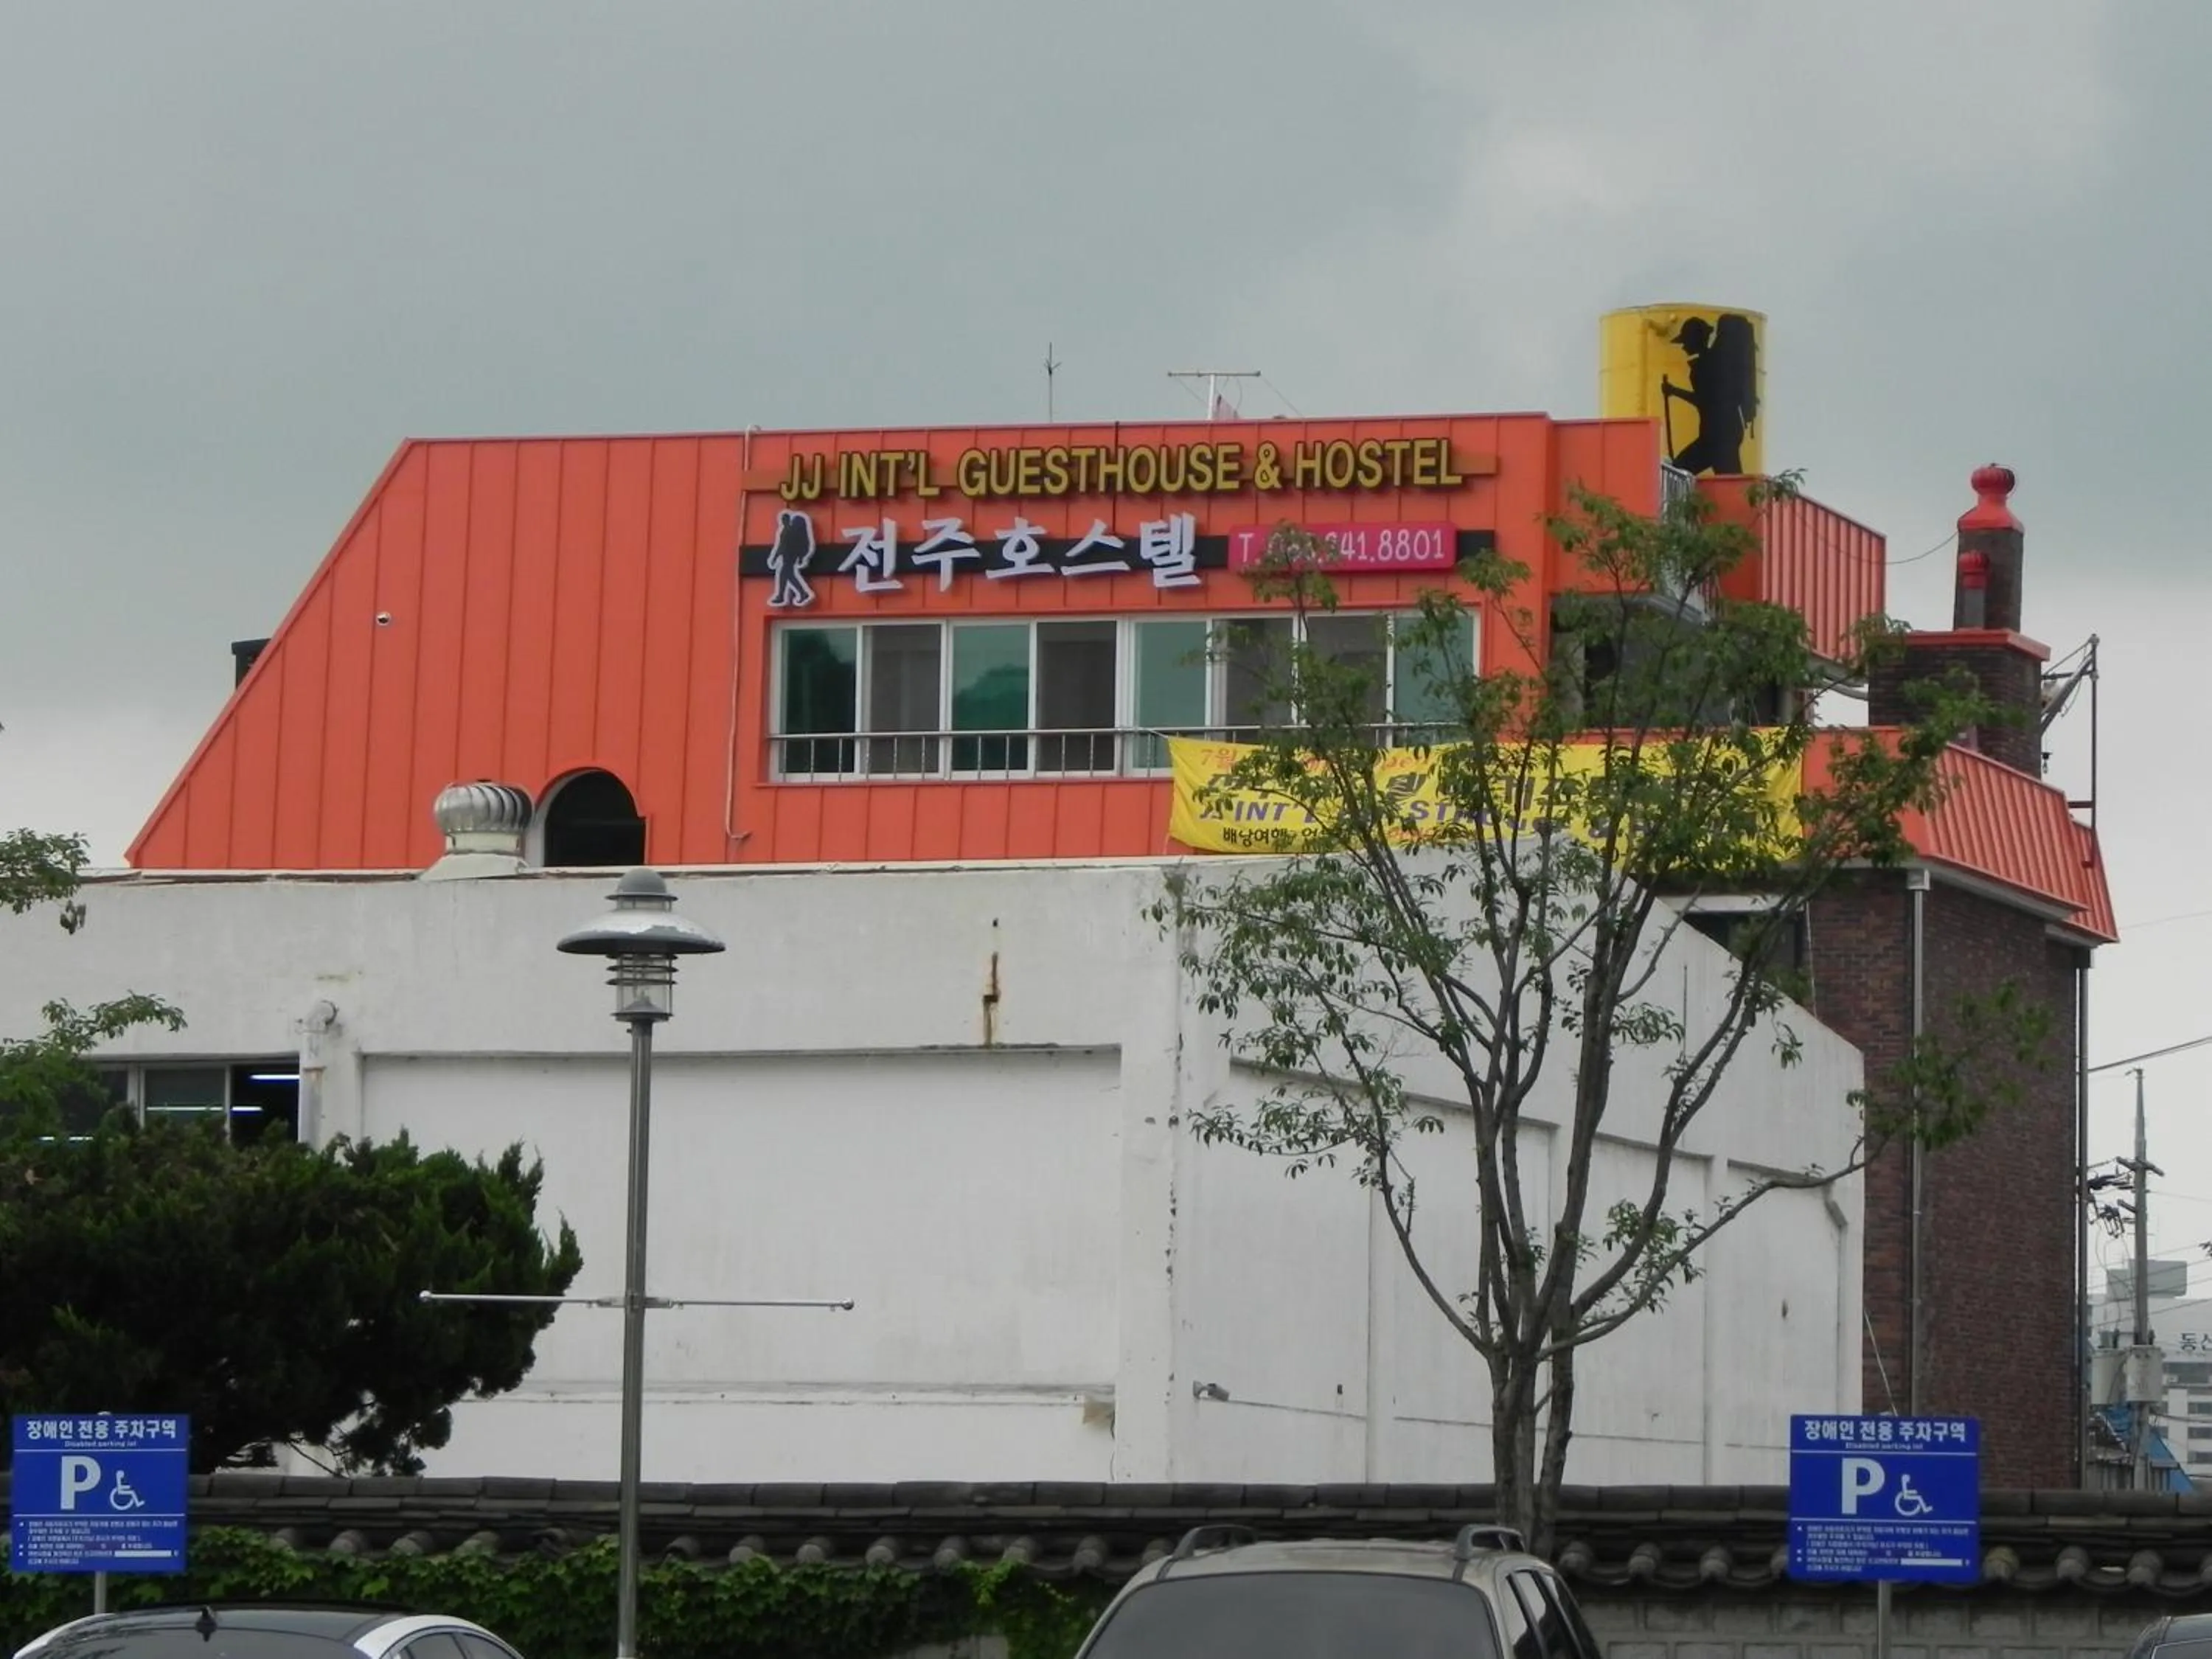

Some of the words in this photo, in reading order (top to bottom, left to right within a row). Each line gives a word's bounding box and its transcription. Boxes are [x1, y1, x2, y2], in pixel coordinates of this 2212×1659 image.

[779, 453, 824, 500] JJ
[838, 451, 941, 498] INT'L
[959, 444, 1240, 495] GUESTHOUSE
[1254, 442, 1281, 490] &
[1295, 439, 1463, 489] HOSTEL
[838, 512, 1202, 593] 전주호스텔
[1238, 528, 1445, 565] T..41.8801
[27, 1419, 73, 1440] 장애인
[77, 1419, 108, 1440] 전용
[114, 1419, 176, 1439] 주차구역
[1804, 1420, 1854, 1441] 장애인
[1860, 1421, 1893, 1441] 전용
[1899, 1421, 1966, 1442] 주차구역
[60, 1455, 102, 1511] P
[1841, 1457, 1885, 1514] P
